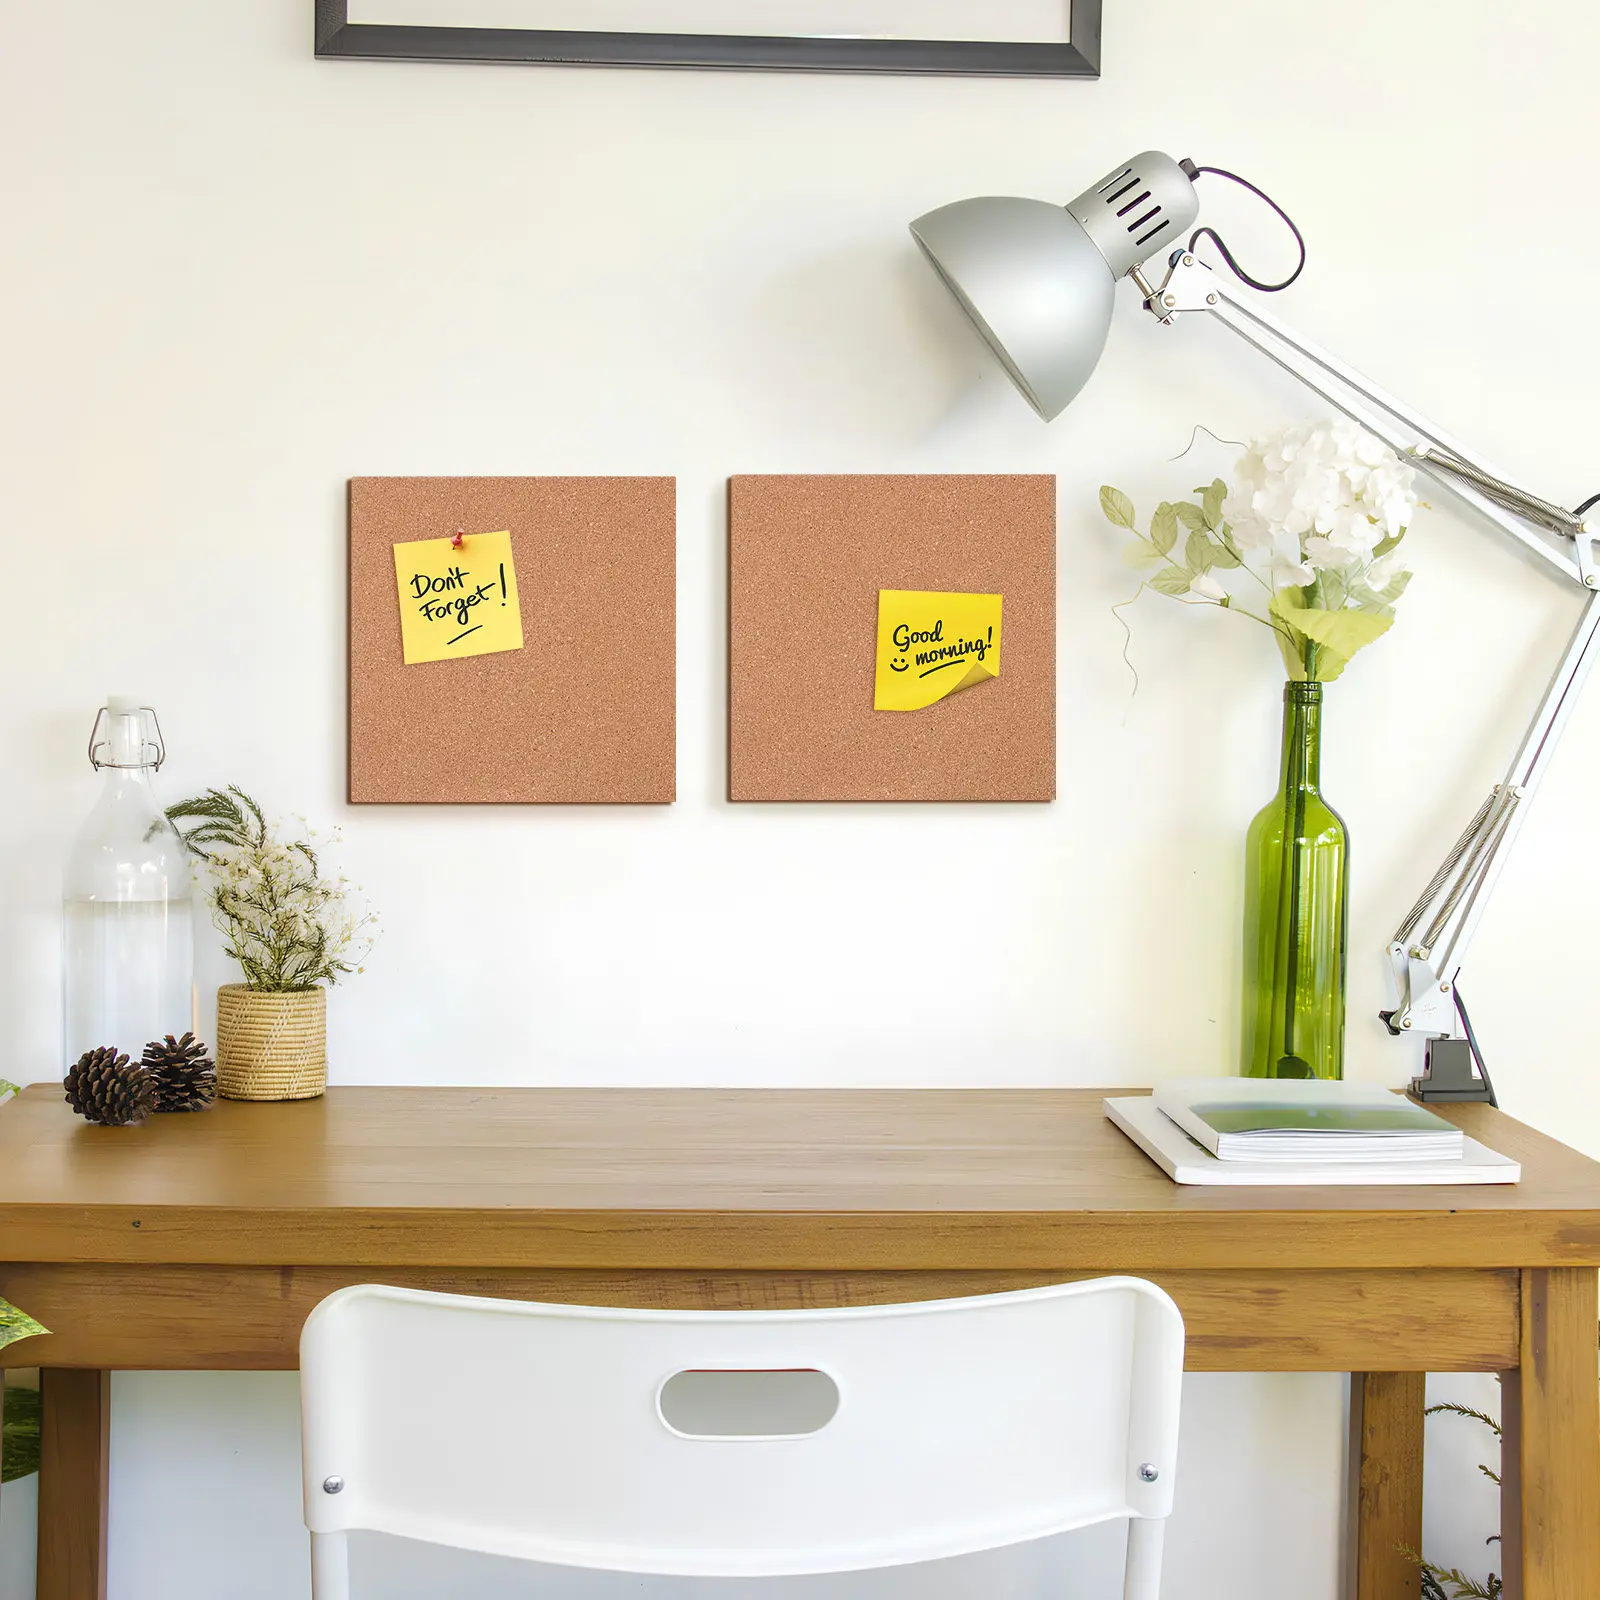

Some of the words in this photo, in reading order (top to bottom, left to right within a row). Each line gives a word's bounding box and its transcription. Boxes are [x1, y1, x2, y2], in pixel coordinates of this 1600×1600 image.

[410, 566, 470, 599] Don't
[892, 619, 944, 653] Good
[915, 626, 993, 666] morning!
